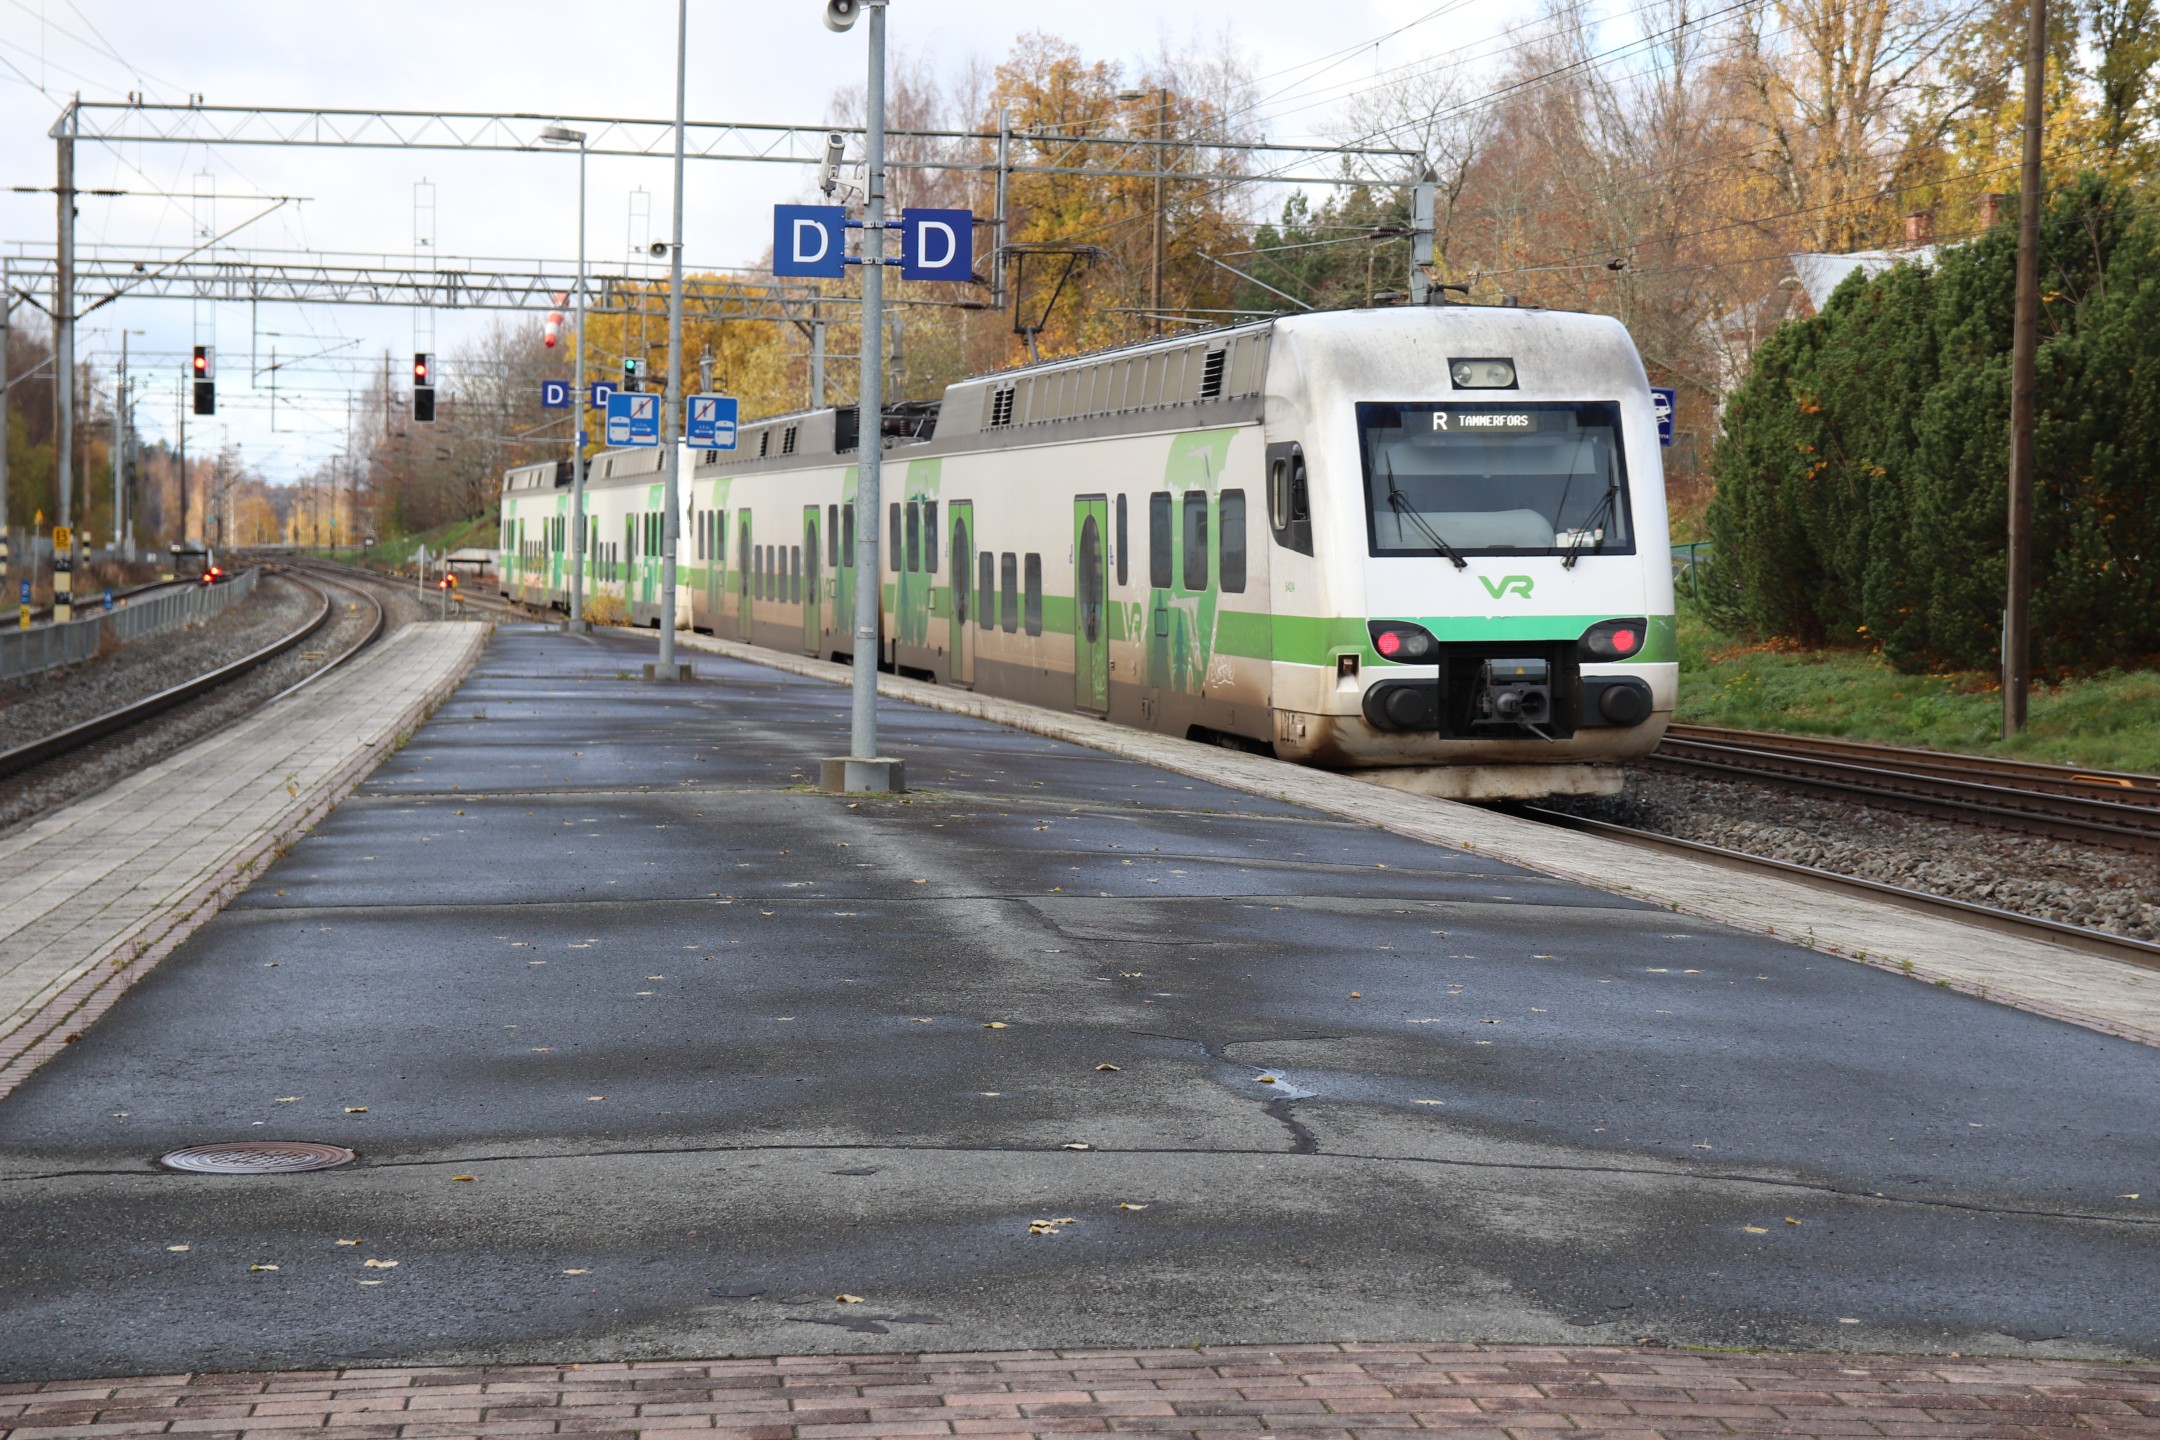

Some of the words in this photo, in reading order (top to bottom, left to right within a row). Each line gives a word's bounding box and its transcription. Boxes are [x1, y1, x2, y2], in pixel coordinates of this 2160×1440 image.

[793, 219, 829, 263] D
[917, 221, 956, 268] D
[547, 385, 564, 404] D
[596, 386, 611, 405] D
[1433, 412, 1448, 430] R
[1458, 415, 1529, 427] TAMMERFORS
[1477, 575, 1534, 600] VR
